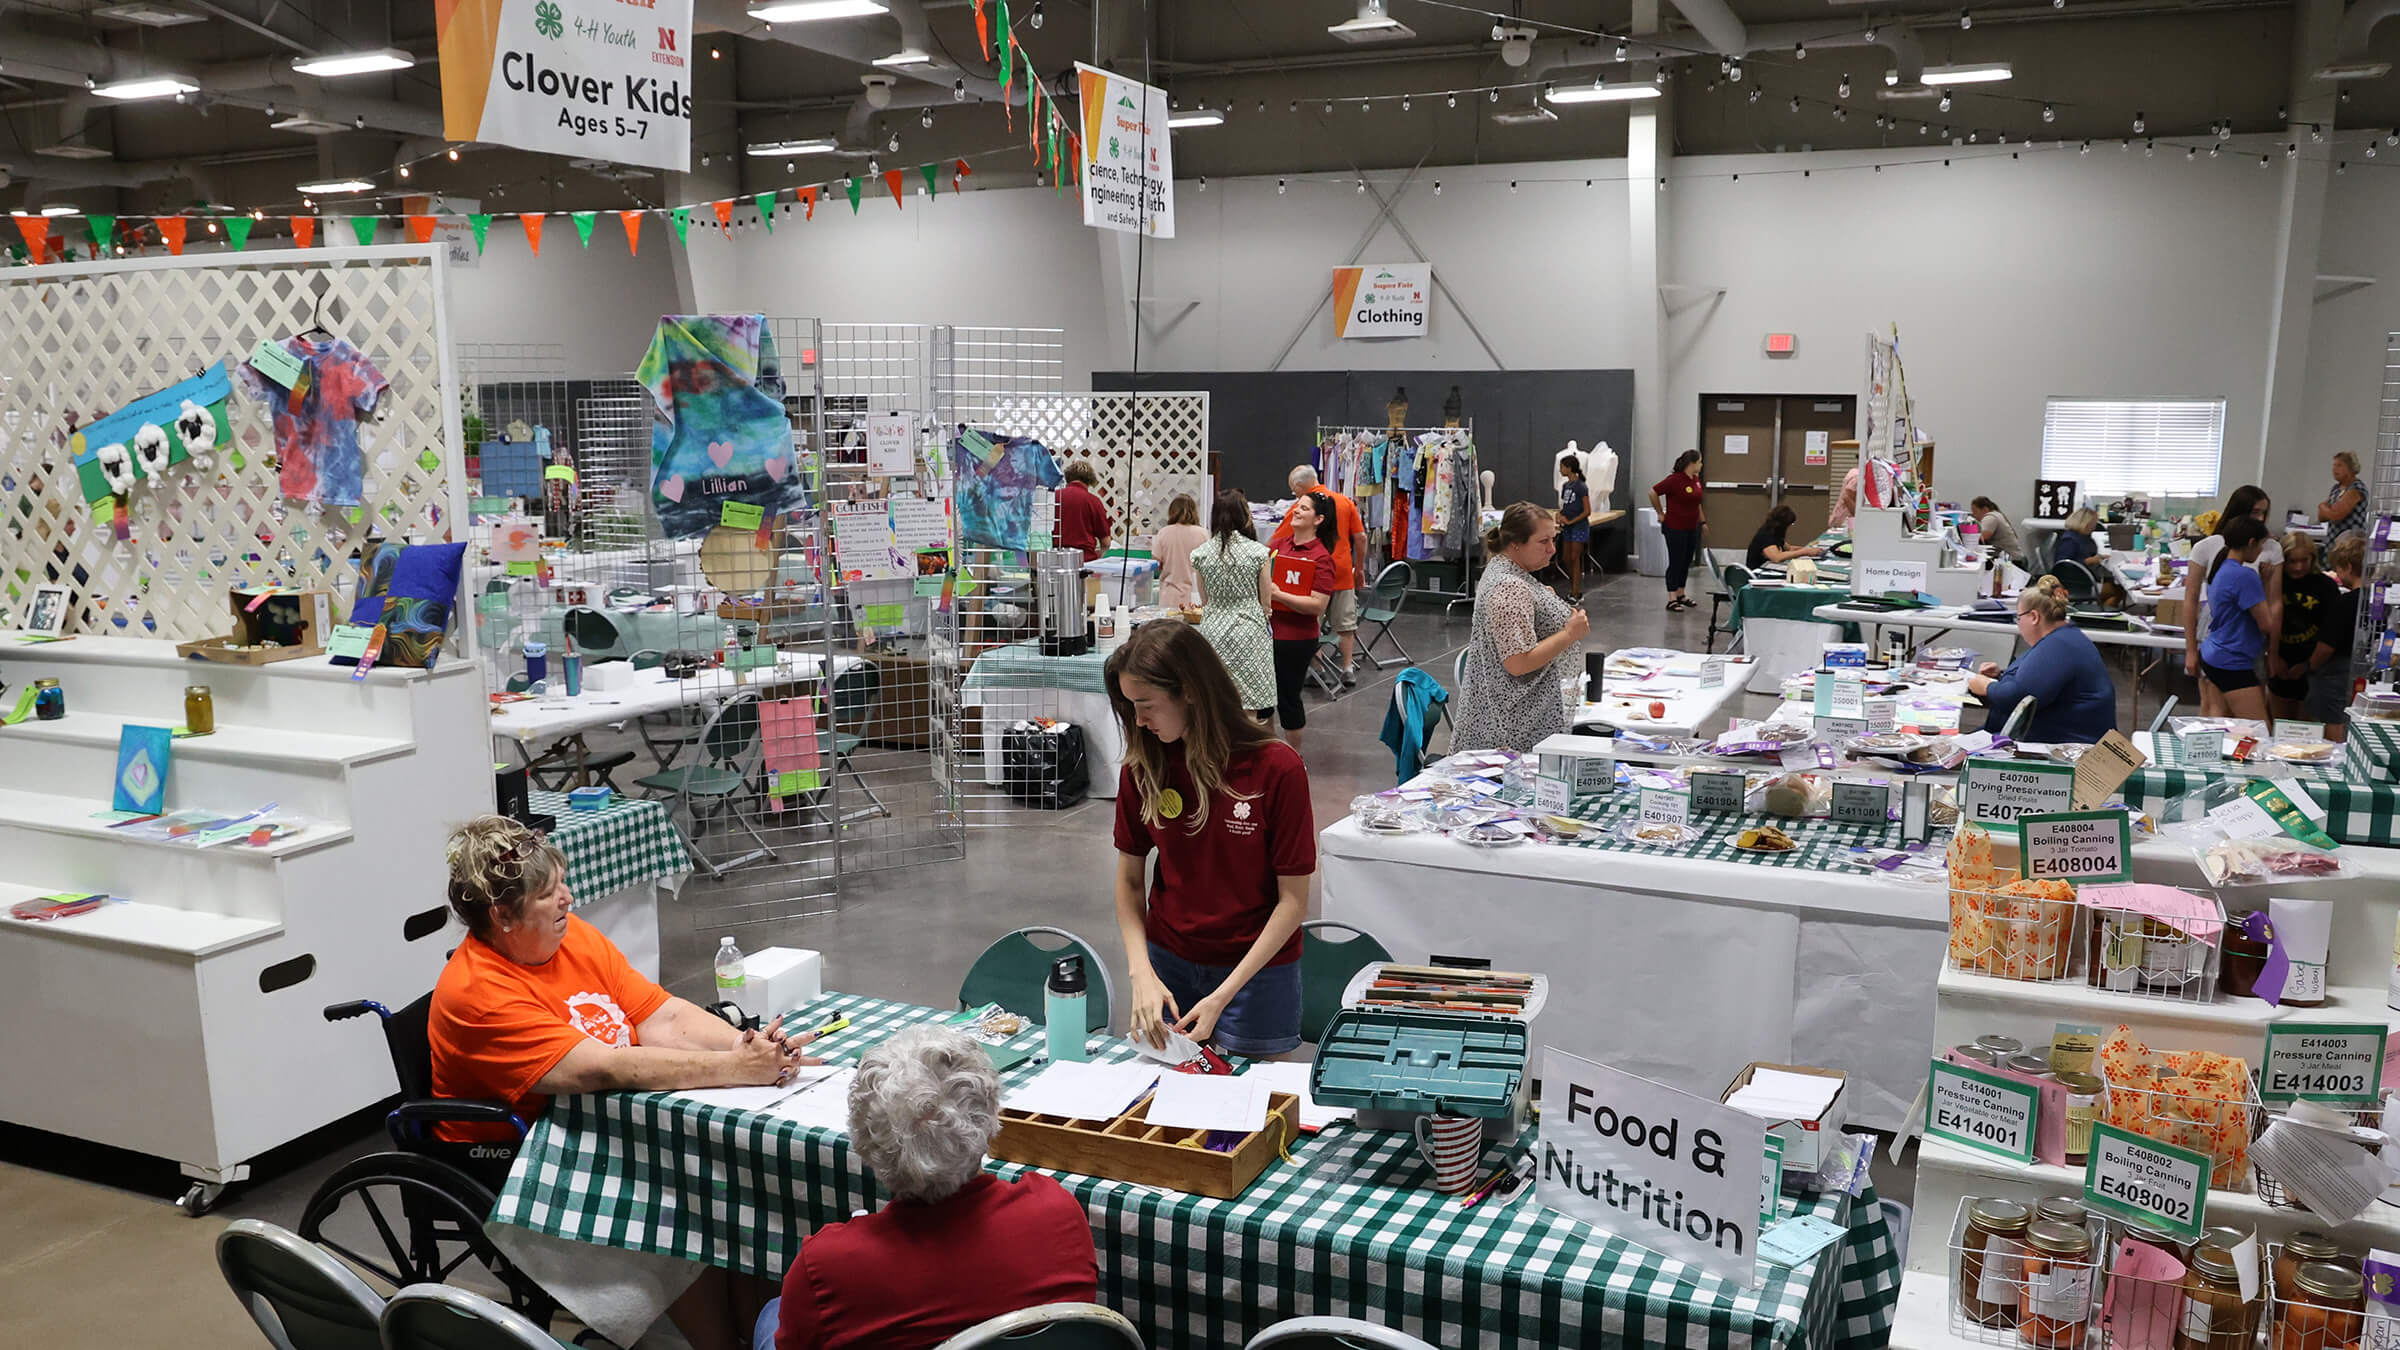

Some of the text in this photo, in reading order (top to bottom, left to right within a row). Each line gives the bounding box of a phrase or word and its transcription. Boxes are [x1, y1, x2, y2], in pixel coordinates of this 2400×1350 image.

[574, 16, 636, 49] 4-H Youth
[658, 27, 676, 51] N
[651, 51, 685, 68] EXTENSION
[502, 51, 692, 119] Clover Kids
[558, 108, 608, 136] Ages
[1116, 115, 1138, 133] Super
[1088, 160, 1119, 182] cience,
[1091, 186, 1135, 211] ngineering
[1357, 308, 1423, 326] Clothing
[702, 478, 748, 495] Lillian
[1285, 570, 1301, 585] N
[1865, 568, 1921, 579] Home Design
[1833, 697, 1858, 705] 350001
[1577, 777, 1612, 787] E401903
[1999, 773, 2040, 784] E407001
[1970, 781, 2067, 797] Drying Preservation
[1998, 794, 2017, 802] Dried
[1644, 810, 1682, 824] E401907
[1838, 806, 1881, 816] E411001
[2052, 824, 2095, 833] E408004
[2033, 835, 2115, 846] Boiling Canning
[2033, 856, 2118, 874] E408004
[2301, 1038, 2347, 1048] E414003
[2273, 1050, 2372, 1062] Pressure Canning
[1961, 1081, 2002, 1100] E414001
[2273, 1074, 2364, 1091] E414003
[1937, 1086, 2025, 1120] Pressure Canning
[1955, 1101, 1989, 1117] Vegetable
[1567, 1083, 1725, 1178] Food &
[1938, 1109, 2017, 1147] E414001
[469, 1145, 511, 1159] drive
[2127, 1146, 2172, 1168] E408002
[2105, 1152, 2192, 1190] Boiling Canning
[2148, 1178, 2166, 1190] Fruit
[1544, 1141, 1743, 1256] Nutrition
[2101, 1175, 2189, 1220] E408002
